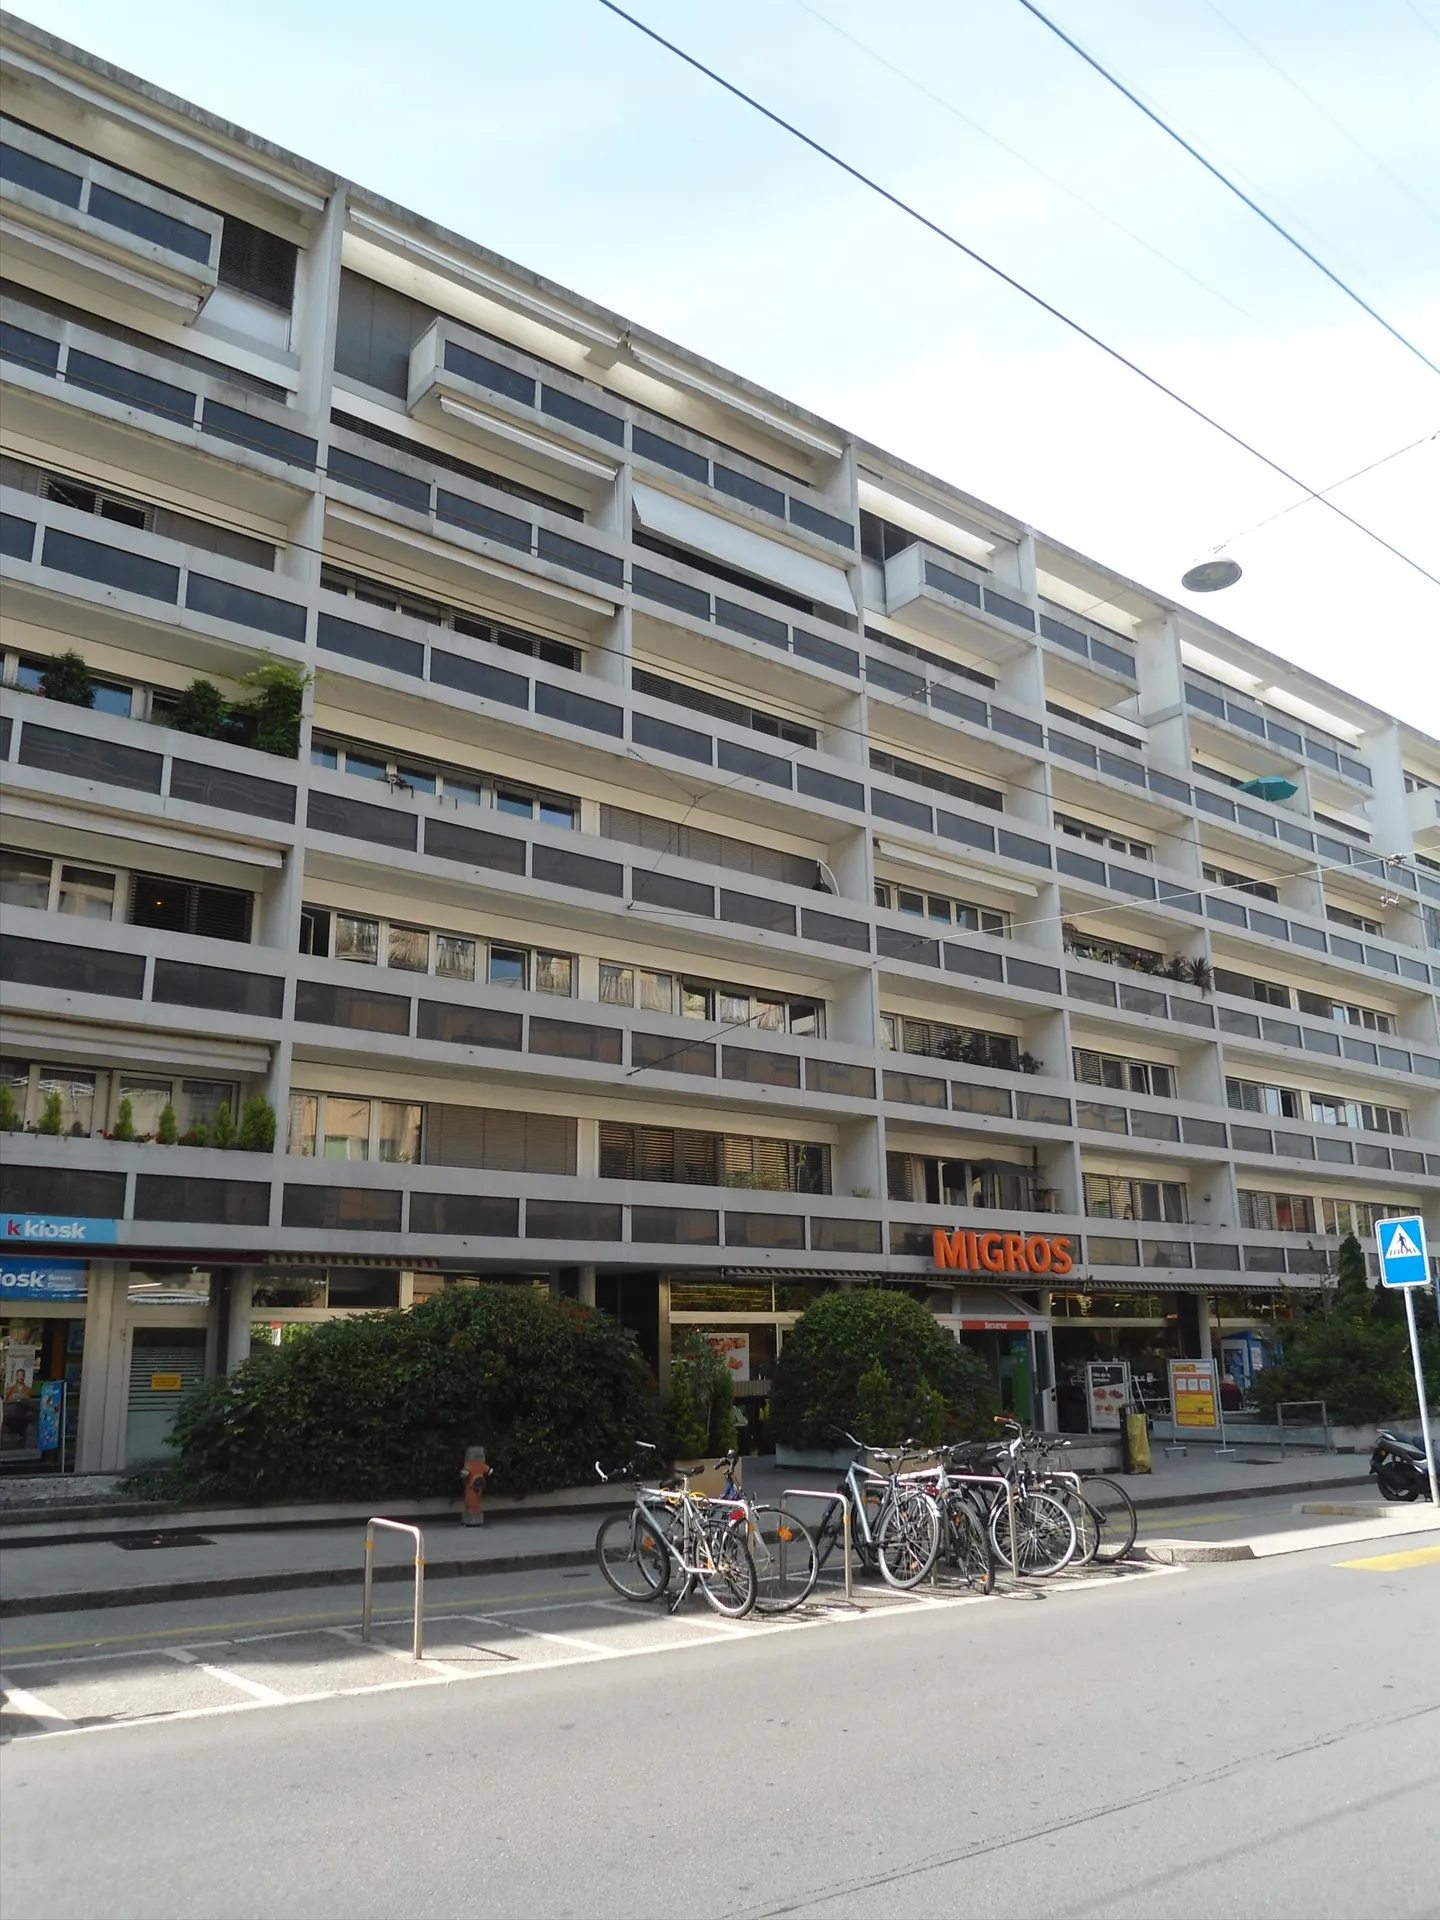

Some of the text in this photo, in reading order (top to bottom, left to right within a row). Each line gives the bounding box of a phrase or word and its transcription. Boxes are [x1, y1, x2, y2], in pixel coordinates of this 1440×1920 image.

[7, 1219, 86, 1239] k kiosk
[933, 1228, 1073, 1275] MIGROS
